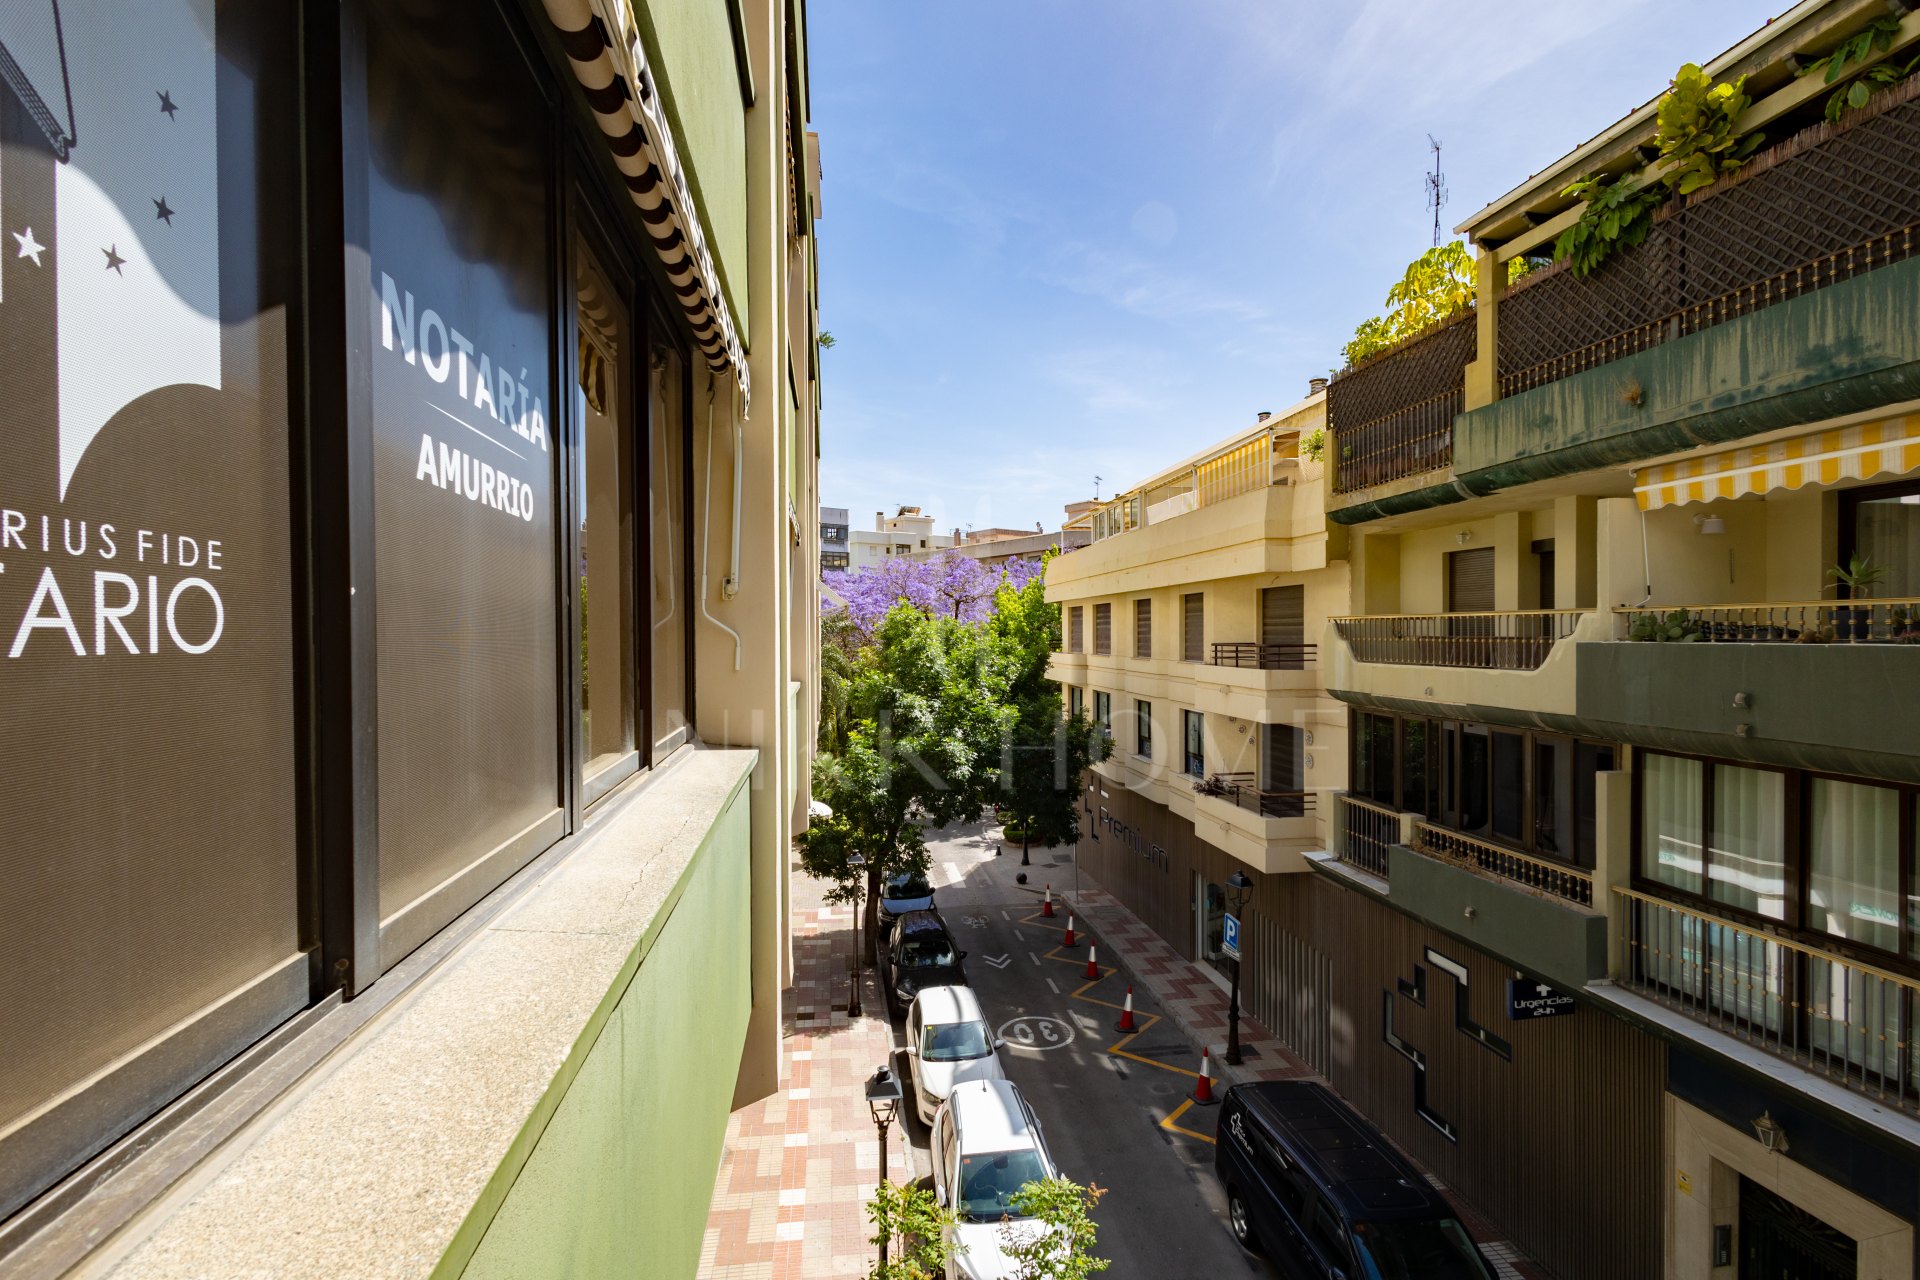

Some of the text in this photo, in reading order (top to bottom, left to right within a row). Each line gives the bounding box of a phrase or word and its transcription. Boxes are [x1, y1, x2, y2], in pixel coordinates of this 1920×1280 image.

[381, 271, 548, 452] NOTARÍA
[416, 433, 534, 522] AMURRIO
[138, 530, 222, 571] FIDE
[0, 563, 224, 658] ARIO
[1099, 805, 1168, 873] Premium
[1226, 919, 1236, 942] P
[1514, 996, 1574, 1010] Urgencias
[1533, 1007, 1555, 1016] 24h
[1013, 1021, 1059, 1044] 30
